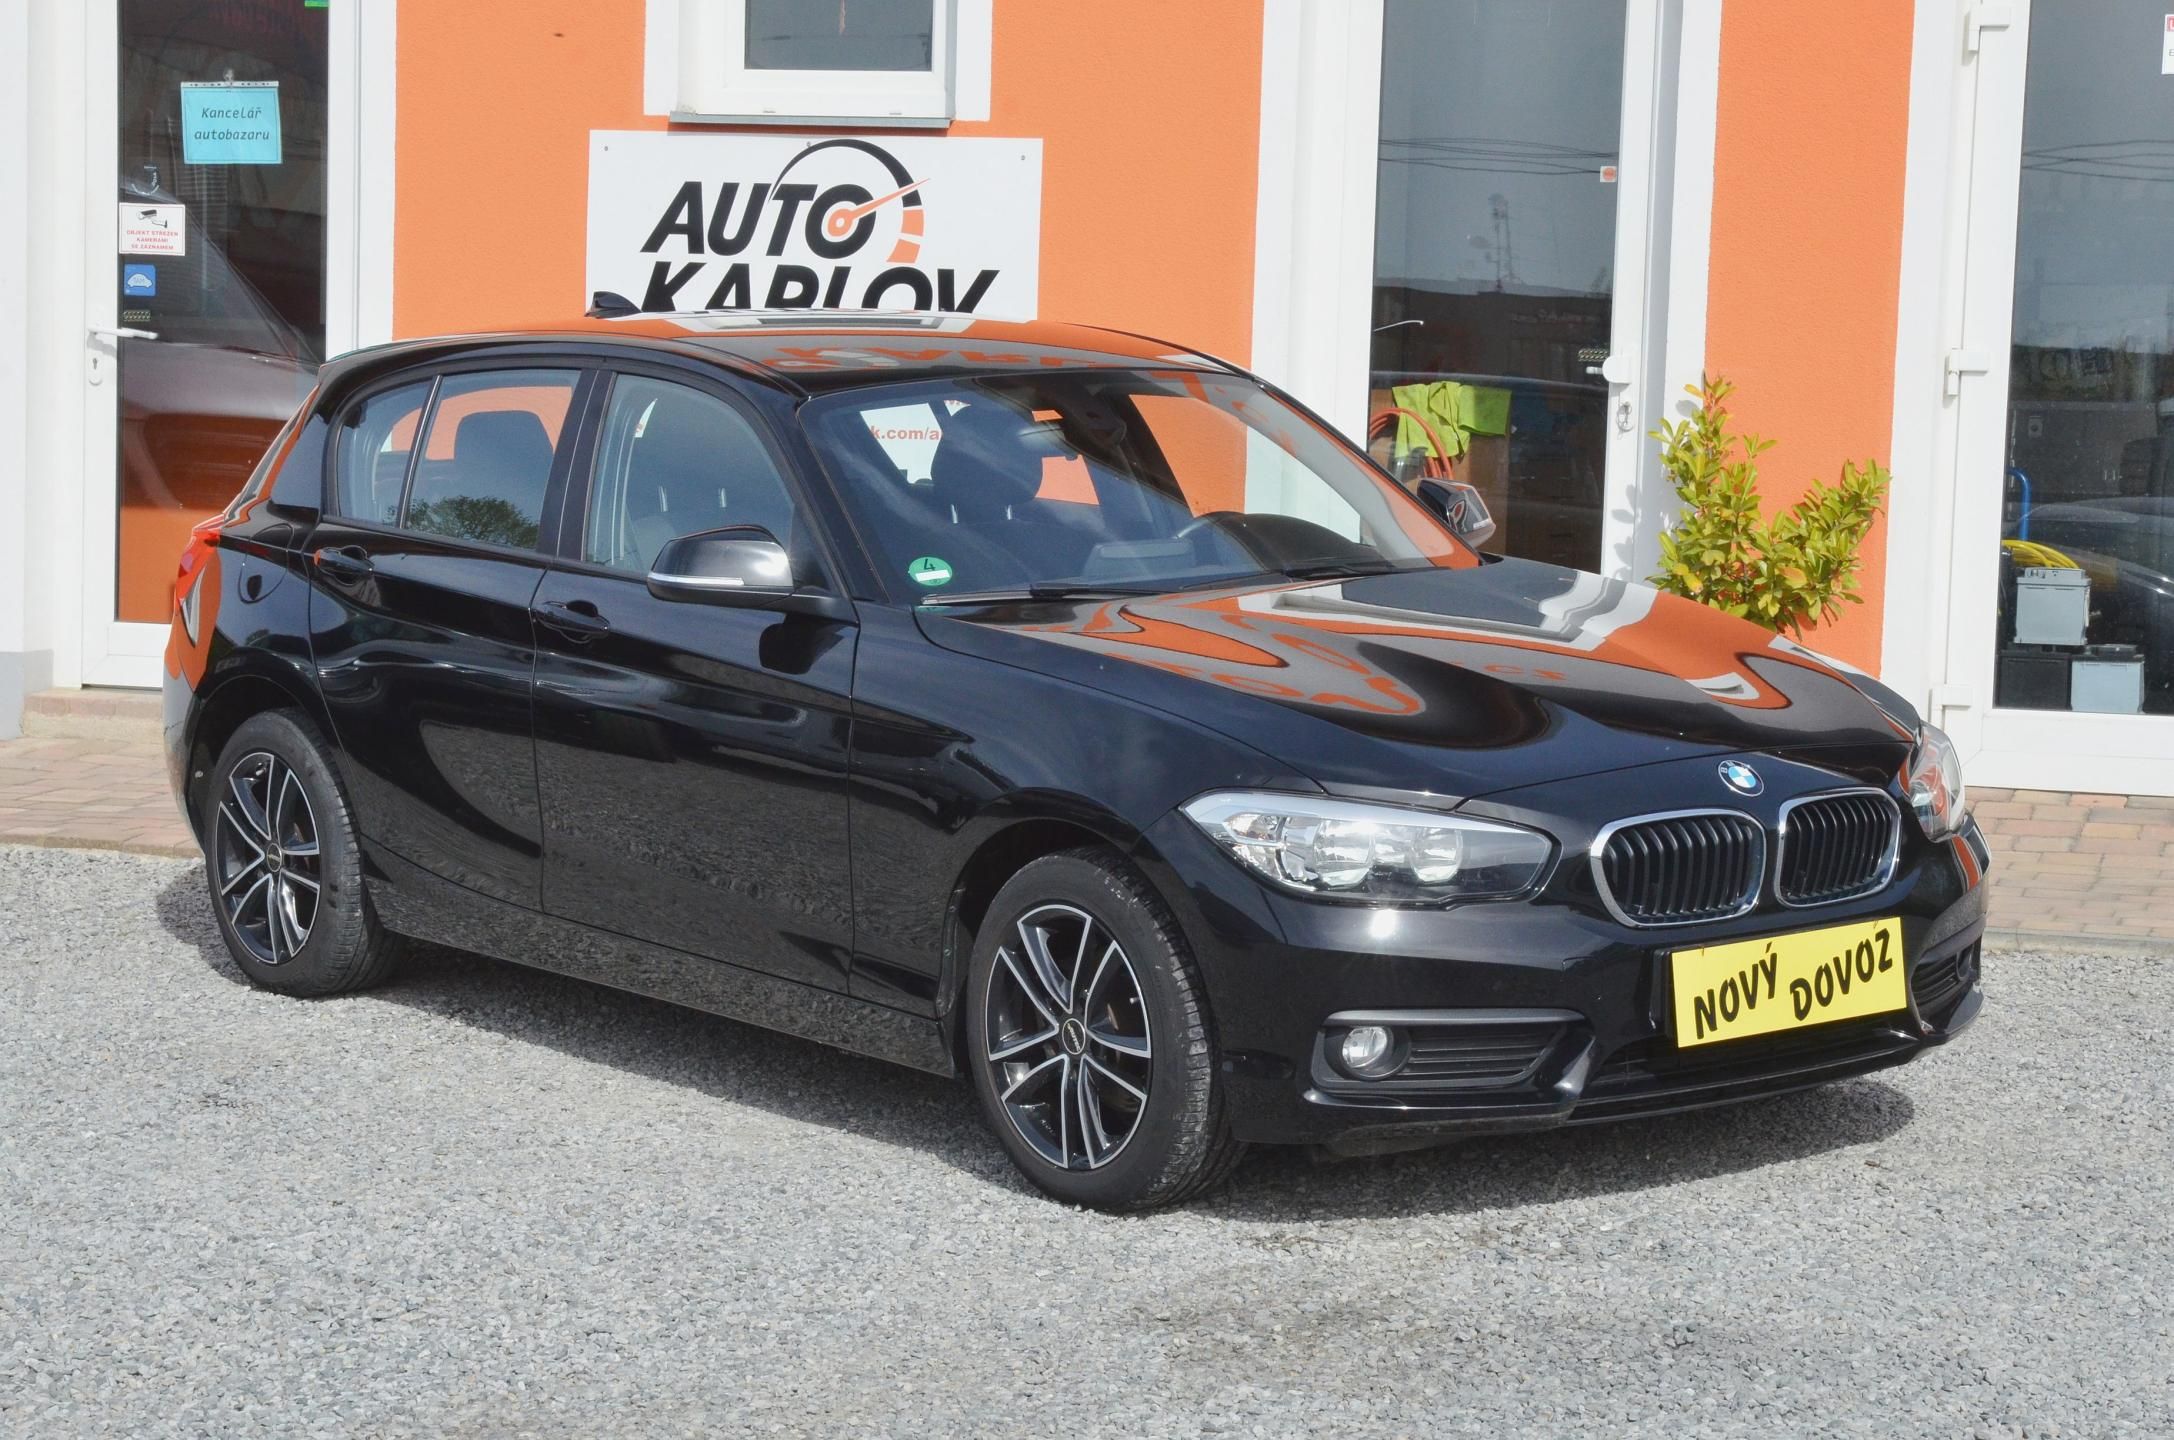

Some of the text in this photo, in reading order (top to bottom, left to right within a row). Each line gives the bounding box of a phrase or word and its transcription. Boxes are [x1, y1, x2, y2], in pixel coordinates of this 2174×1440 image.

[201, 106, 262, 119] Kancelář
[194, 129, 270, 141] autobazaru
[640, 181, 877, 260] AUTO
[924, 558, 936, 571] 4
[1694, 928, 1893, 1039] NOVÝ DOVOZ
